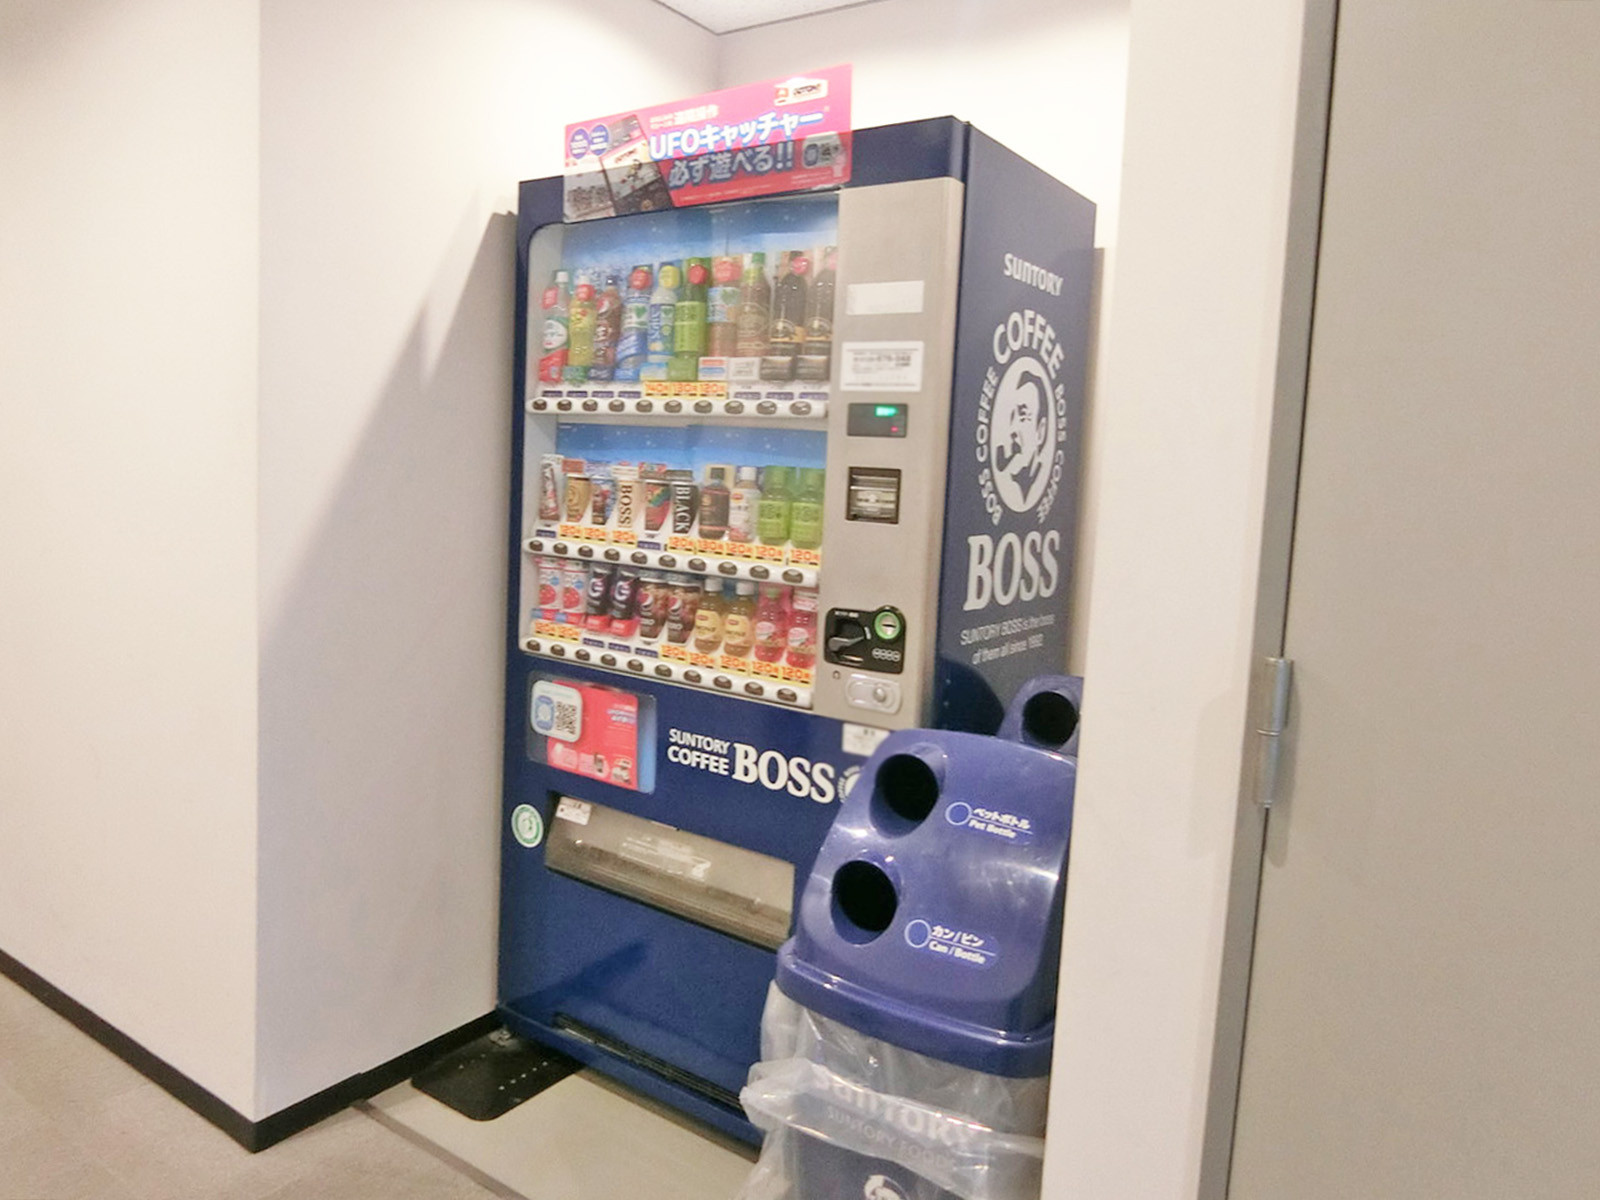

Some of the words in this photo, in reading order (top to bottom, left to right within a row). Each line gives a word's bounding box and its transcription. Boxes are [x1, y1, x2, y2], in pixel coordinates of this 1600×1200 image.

[649, 111, 824, 160] UFOキャッチャー
[1003, 252, 1064, 297] SUNTORY
[993, 309, 1065, 380] COFFEE
[975, 366, 1000, 463] COFFEE
[618, 485, 633, 526] BOSS
[674, 486, 691, 533] BLACK
[963, 529, 1061, 612] BOSS
[667, 745, 730, 776] COFFEE
[669, 728, 730, 753] SUNTORY
[732, 742, 836, 804] BOSS
[973, 807, 1032, 830] ペットボトル
